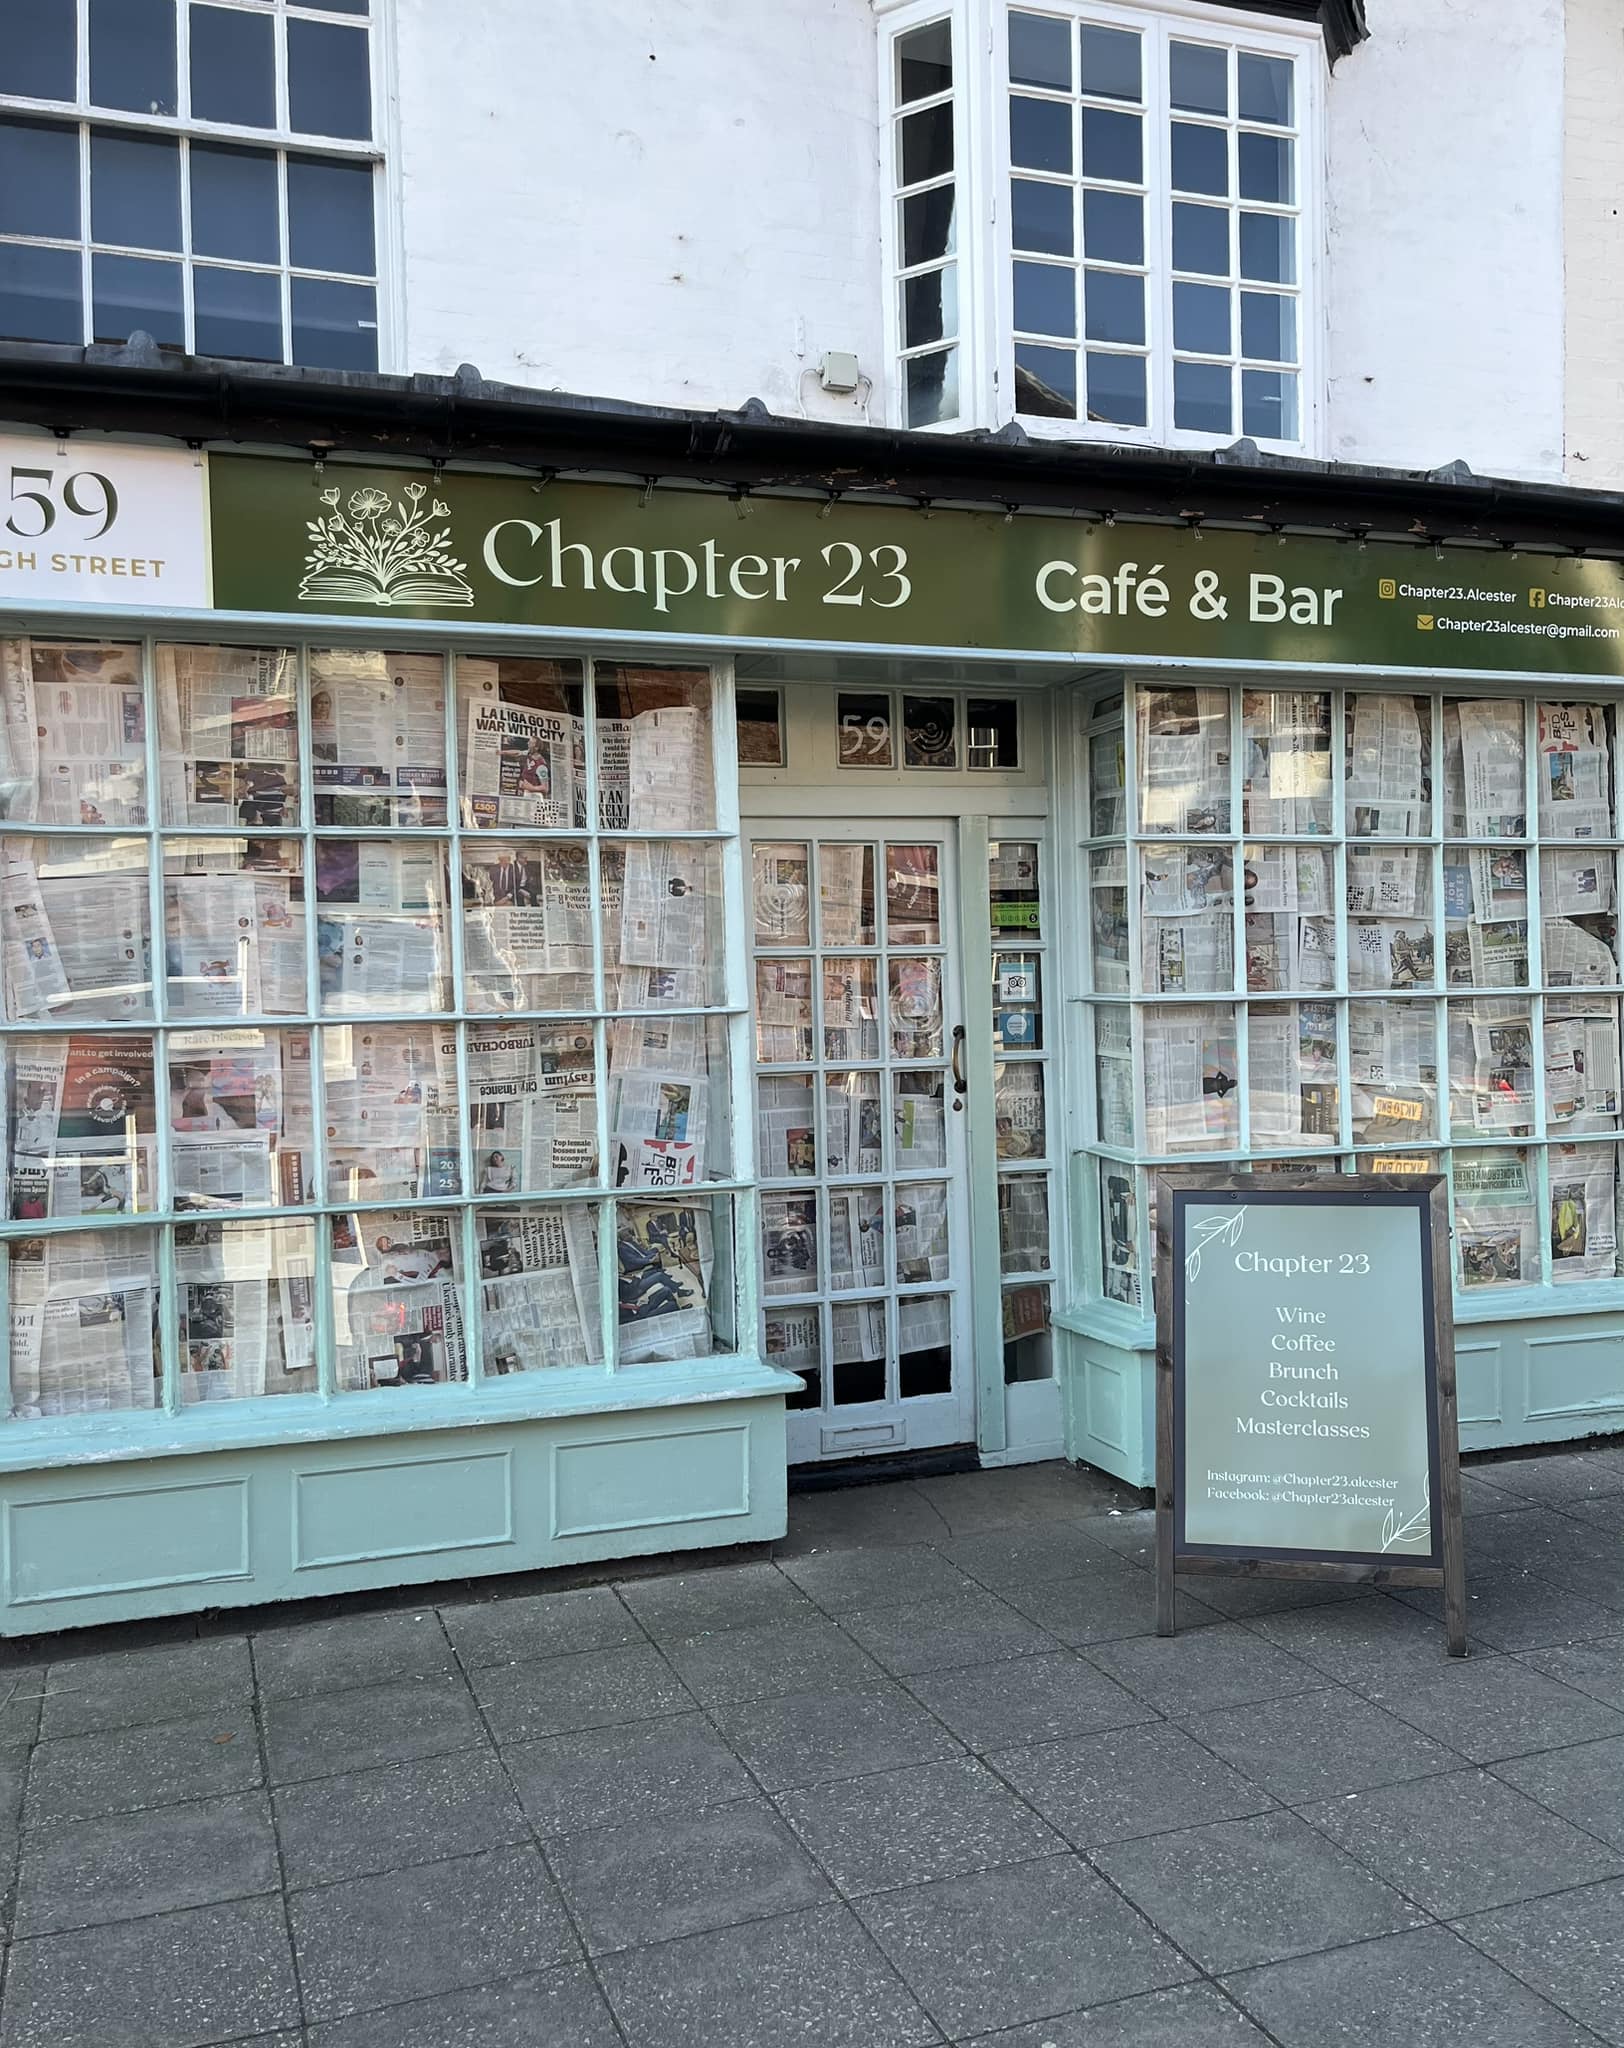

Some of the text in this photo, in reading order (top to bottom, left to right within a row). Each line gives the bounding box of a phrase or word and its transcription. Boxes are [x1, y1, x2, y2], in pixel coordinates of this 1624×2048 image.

[6, 466, 119, 541] 59
[51, 554, 165, 577] STREET
[483, 518, 912, 613] Chapter 23
[1036, 560, 1343, 625] Café & Bar
[1399, 584, 1517, 603] Chapter23.Alcester
[1437, 617, 1619, 639] Chapter23alcester@gmail.com
[481, 707, 499, 722] LA
[500, 709, 526, 725] LIGA
[528, 714, 544, 729] GO
[547, 718, 560, 731] TO
[476, 718, 565, 744] WAR WITH CITY
[842, 714, 889, 755] 59
[608, 791, 623, 803] AN
[115, 1050, 153, 1058] involved
[545, 1073, 588, 1086] asylum
[1235, 1251, 1370, 1278] Chapter 23
[1276, 1307, 1326, 1324] Wine
[1271, 1334, 1336, 1352] Coffee
[446, 1341, 458, 1382] guarante
[1269, 1362, 1339, 1380] Brunch
[1261, 1390, 1349, 1409] Cocktails
[1236, 1417, 1370, 1439] Masterclasses
